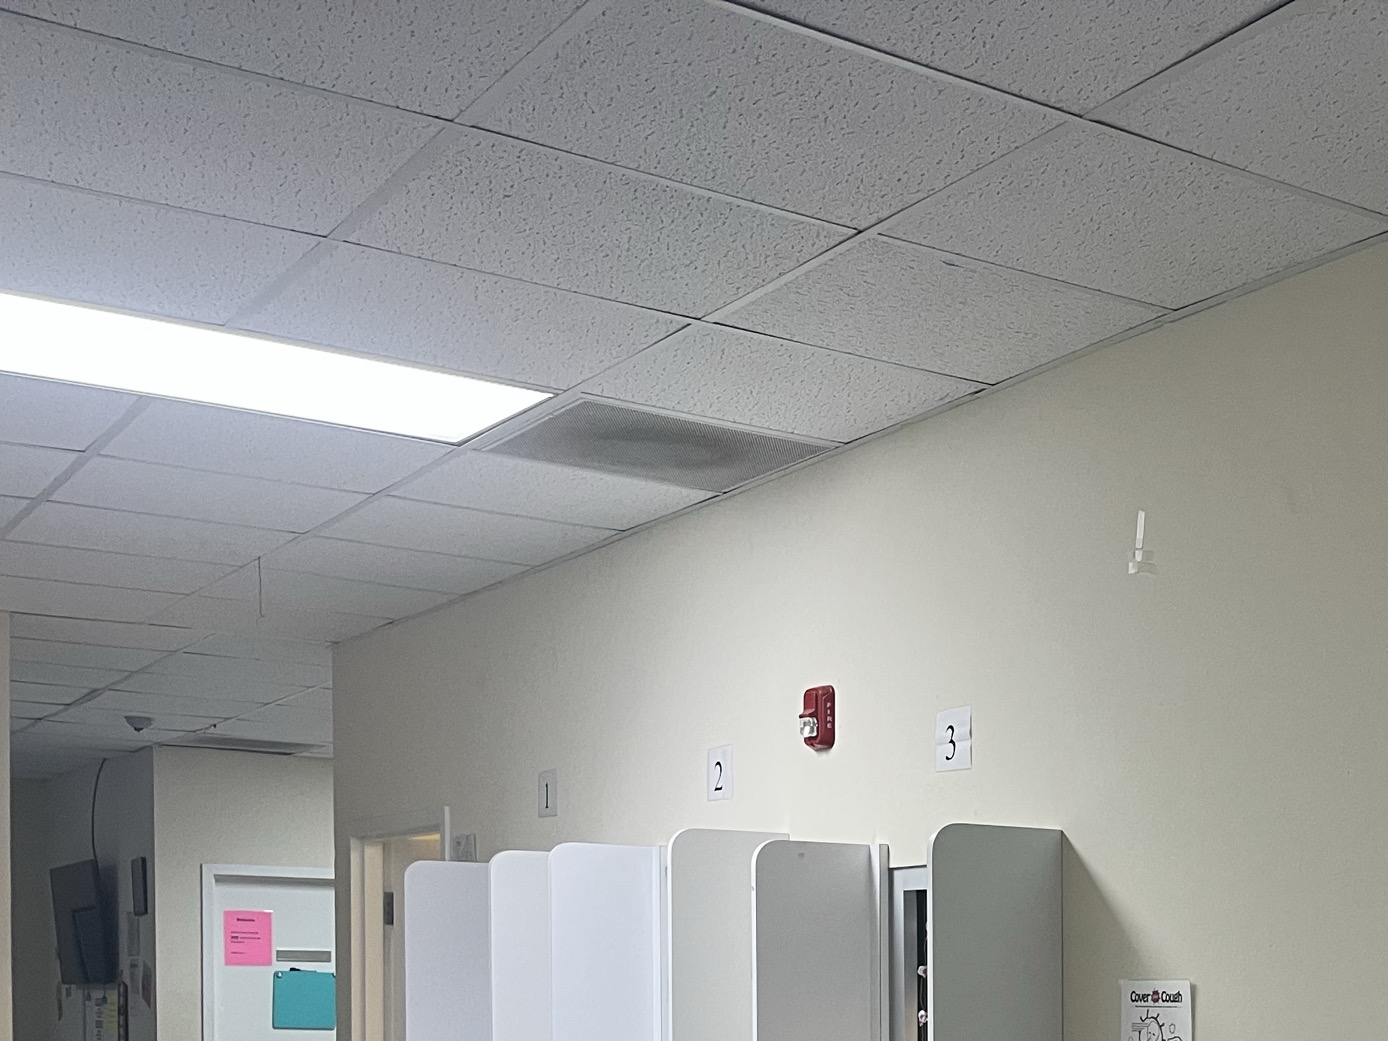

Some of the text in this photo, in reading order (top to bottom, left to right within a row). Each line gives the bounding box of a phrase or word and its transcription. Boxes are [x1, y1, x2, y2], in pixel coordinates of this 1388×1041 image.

[945, 724, 956, 761] 3
[713, 761, 723, 791] 2
[1130, 990, 1183, 1003] Cover Cough
